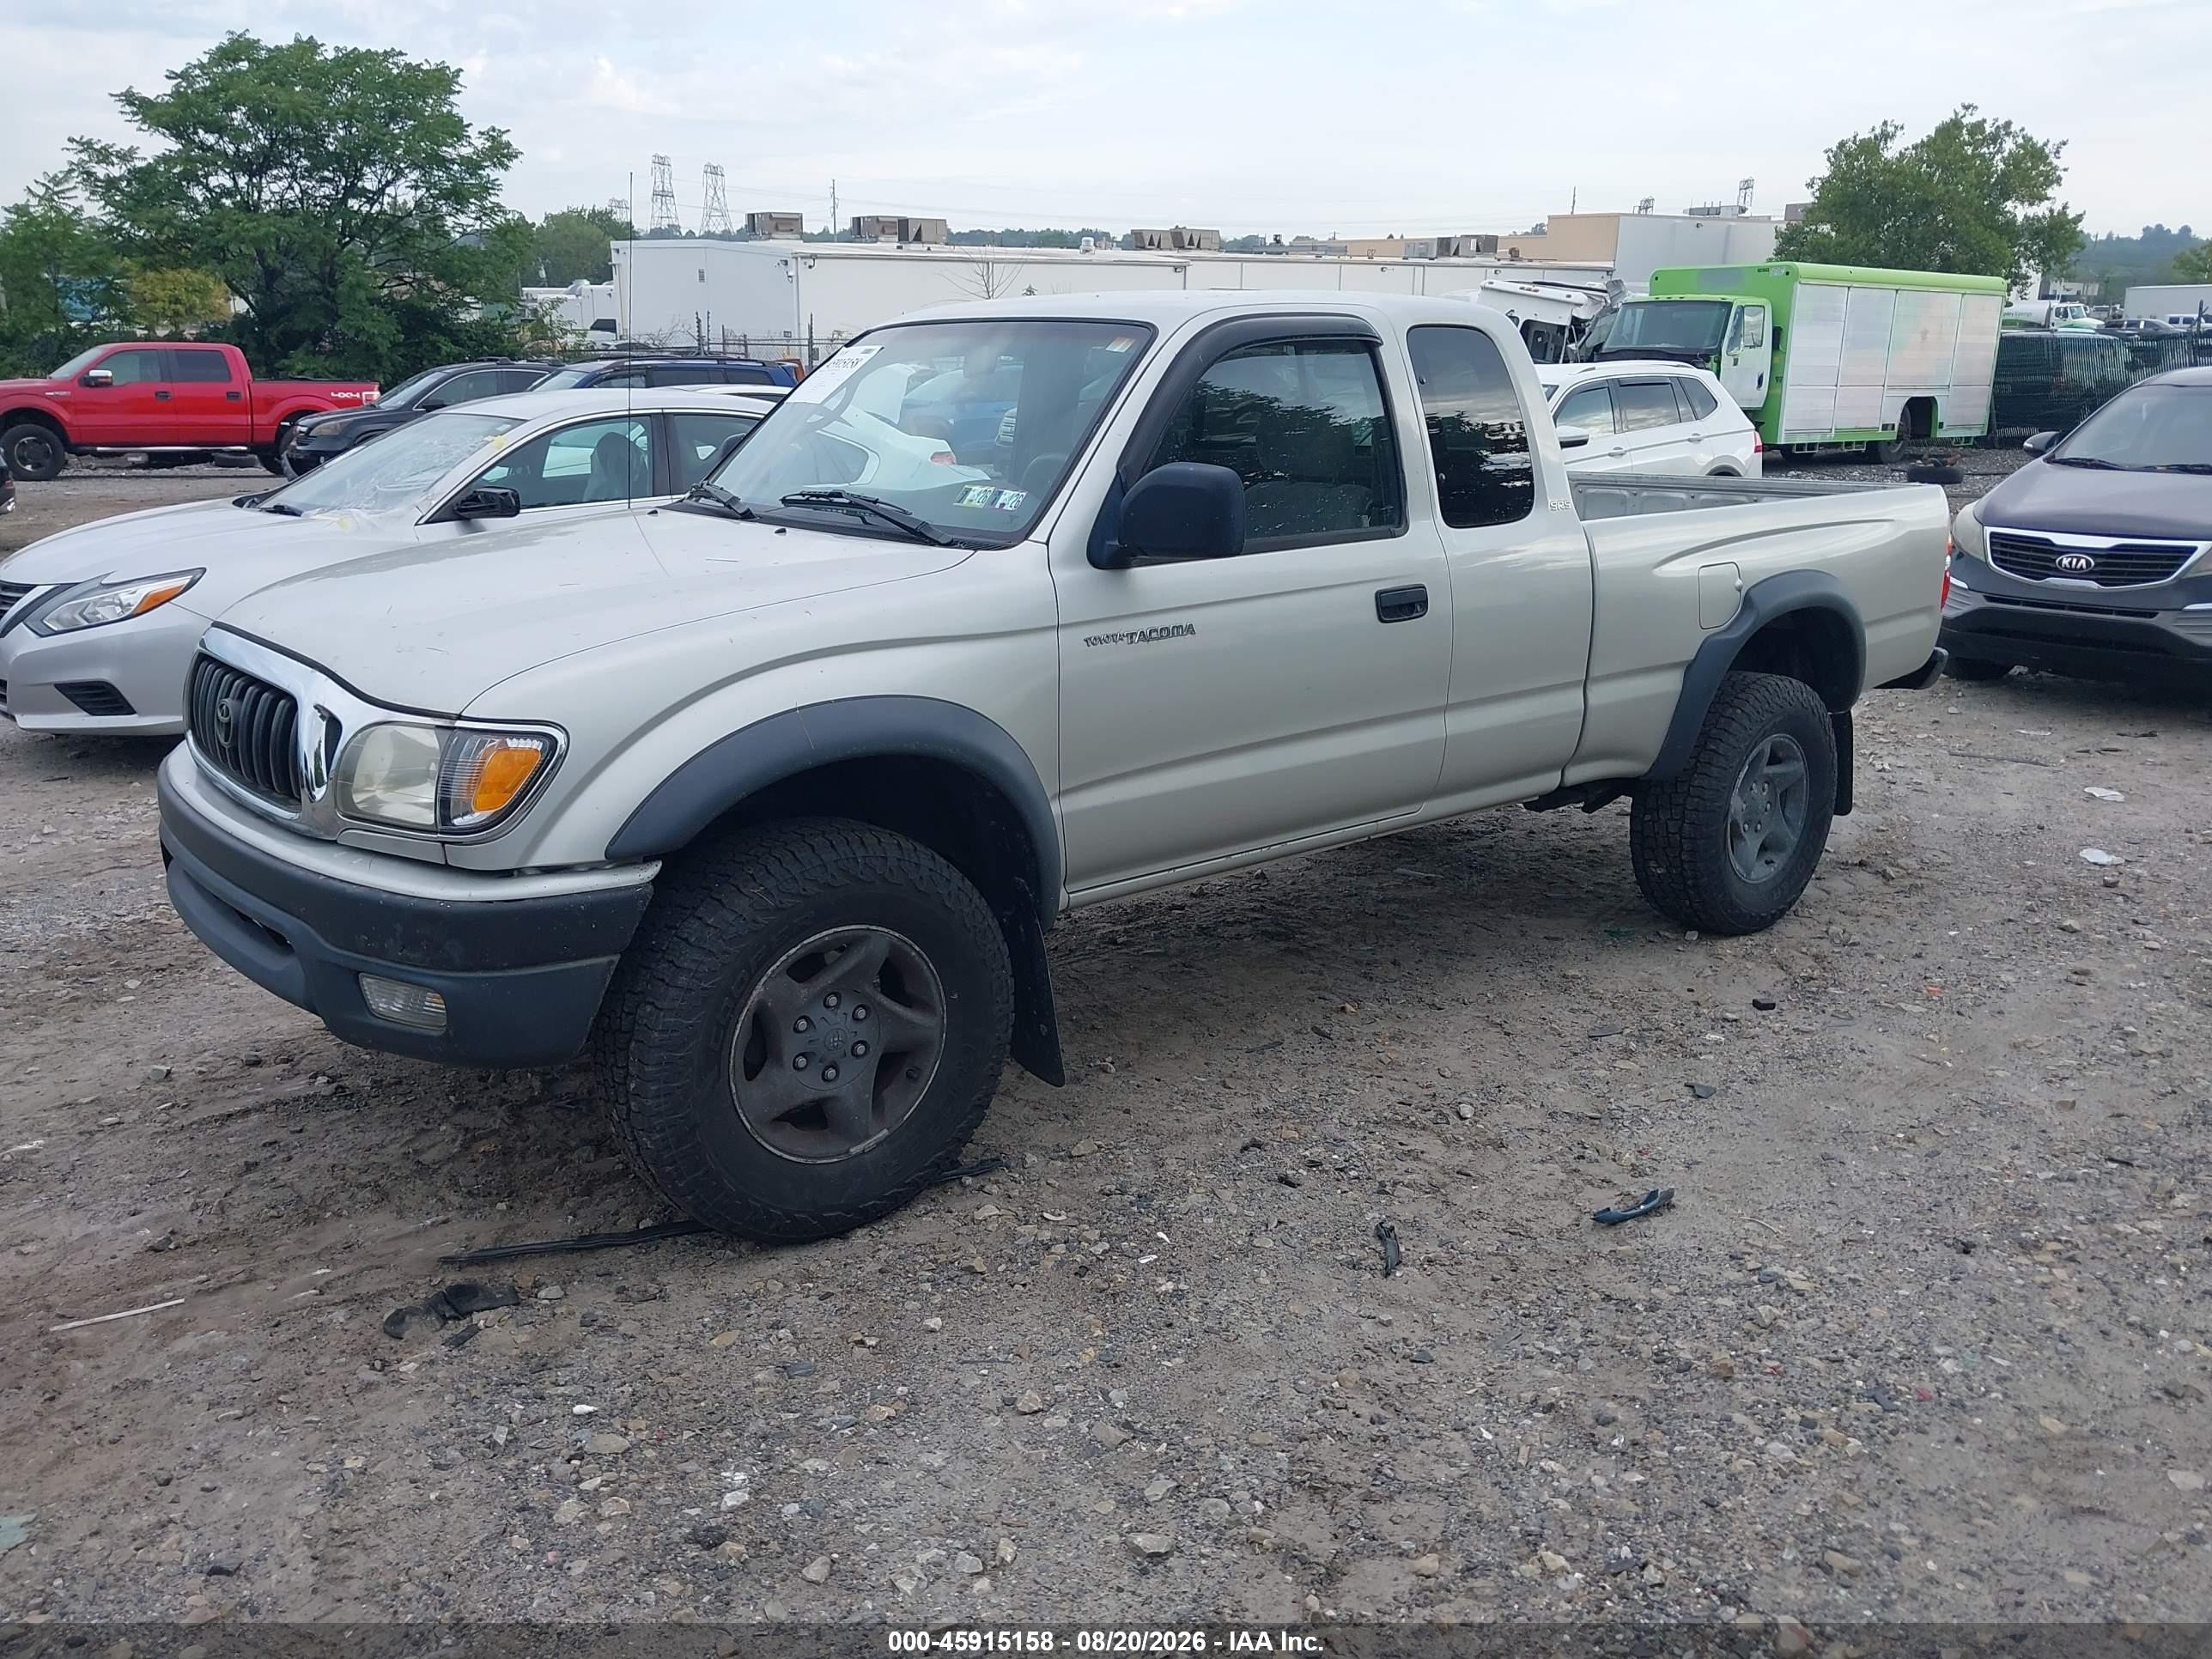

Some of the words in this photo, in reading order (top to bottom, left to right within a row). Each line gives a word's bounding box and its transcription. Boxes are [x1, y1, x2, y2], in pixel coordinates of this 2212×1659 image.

[2062, 557, 2087, 569] KIA
[1083, 633, 1124, 647] TOYOTA
[1124, 623, 1195, 644] TACOMA
